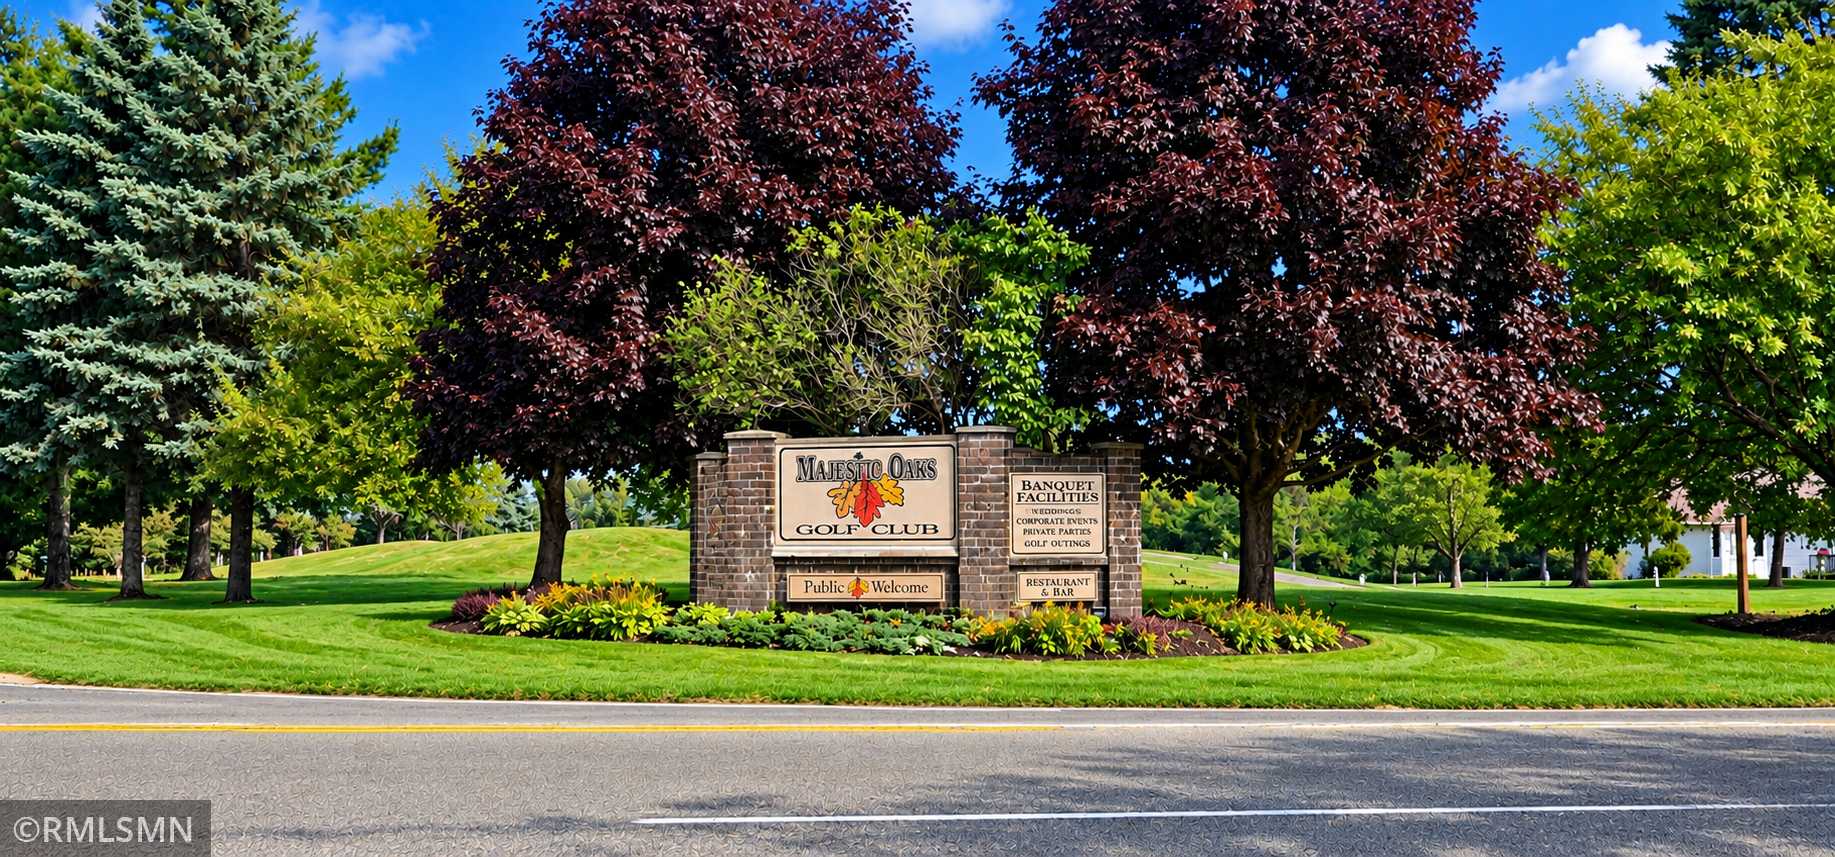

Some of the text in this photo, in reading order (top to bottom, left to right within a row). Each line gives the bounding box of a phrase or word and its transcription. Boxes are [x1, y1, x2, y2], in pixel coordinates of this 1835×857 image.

[796, 453, 938, 482] MAJESTIC OAKS
[1021, 480, 1095, 492] BANQUET
[1016, 492, 1099, 503] FACILITIES
[1016, 517, 1099, 526] CORPORATE EVENTS
[796, 524, 939, 535] GOLF CLUB
[1022, 528, 1092, 536] PRIVATE PARTIES
[1024, 540, 1091, 548] GOLF OUTINGS
[804, 580, 929, 594] Public Welcome
[1026, 578, 1091, 587] RESTAURANT
[1041, 587, 1075, 597] & BAR
